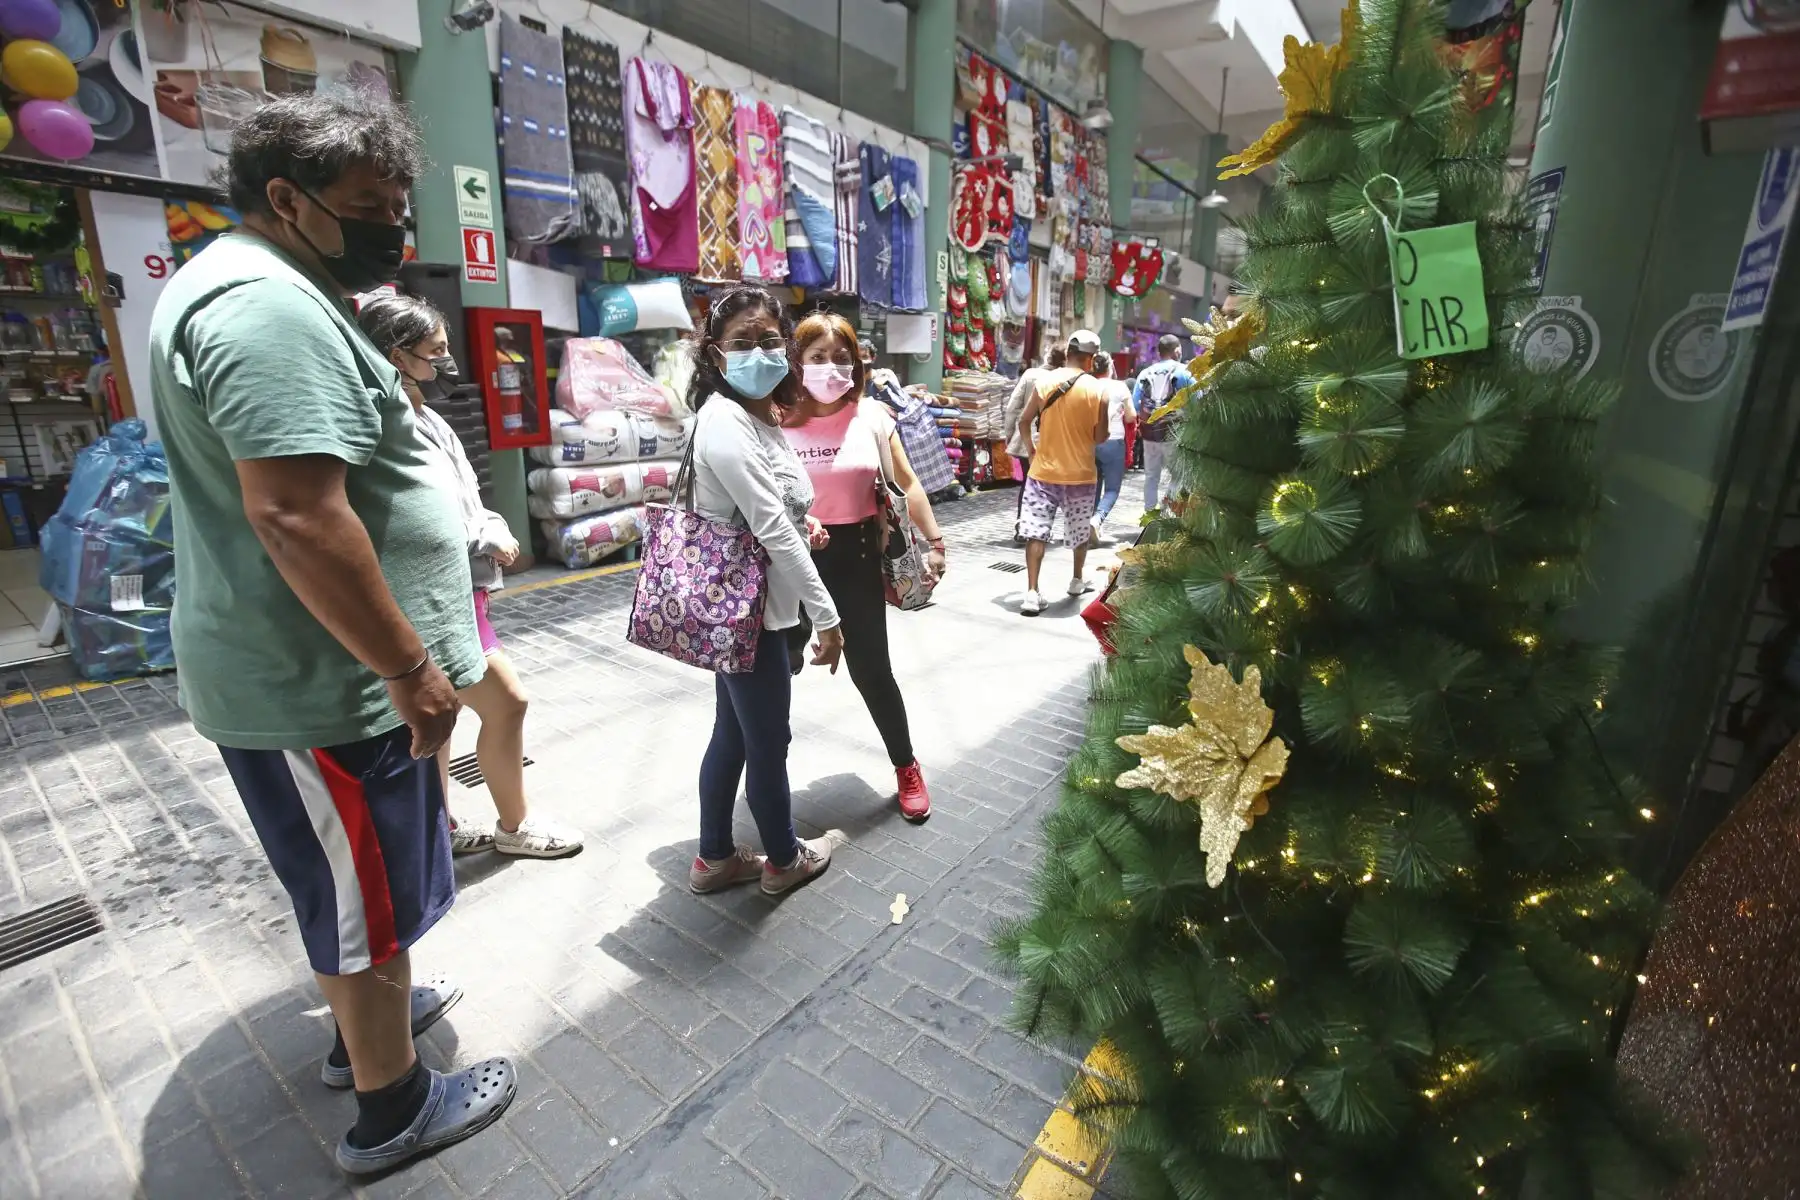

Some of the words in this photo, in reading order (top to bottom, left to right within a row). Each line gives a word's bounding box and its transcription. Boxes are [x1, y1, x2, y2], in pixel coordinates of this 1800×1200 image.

[464, 209, 489, 220] SALIDA
[144, 255, 175, 279] 9
[468, 267, 497, 279] EXTINTOR
